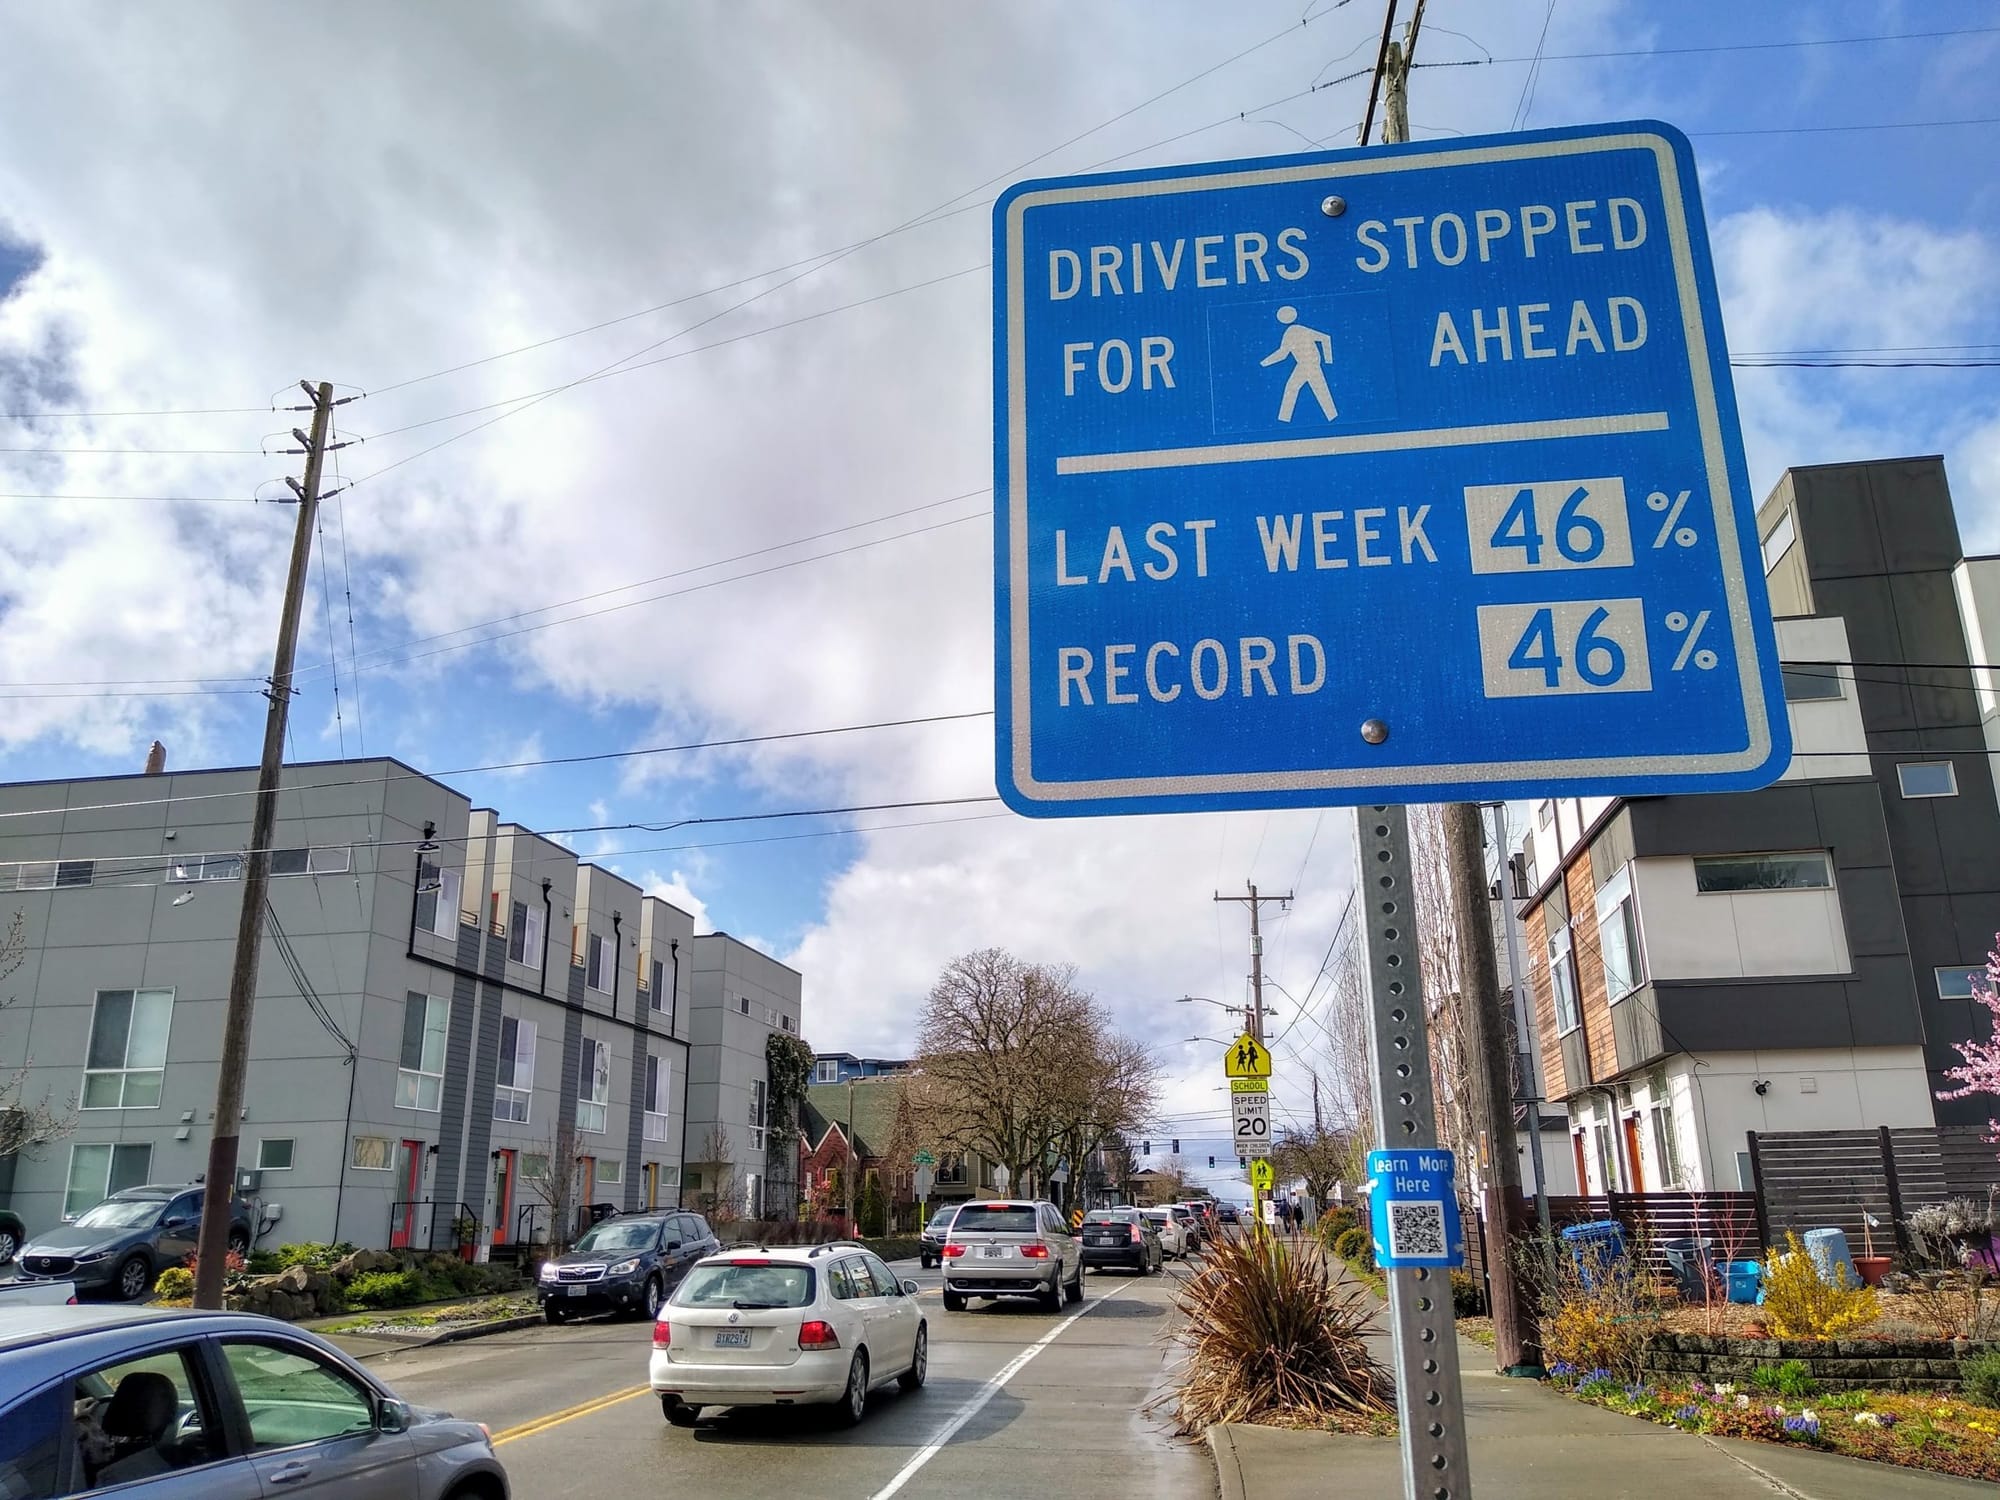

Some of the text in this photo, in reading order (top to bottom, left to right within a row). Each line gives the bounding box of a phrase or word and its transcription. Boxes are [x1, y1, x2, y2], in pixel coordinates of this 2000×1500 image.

[1049, 197, 1647, 302] DRIVERS STOPPED
[1064, 296, 1648, 396] FOR AHEAD
[1056, 487, 1698, 587] LAST WEEK 46 %
[1058, 608, 1719, 707] RECORD 46 %
[1233, 1081, 1265, 1090] SCHOOL
[1234, 1096, 1267, 1105] SPEED
[1238, 1106, 1263, 1115] LIMIT
[1237, 1117, 1267, 1136] 20
[1374, 1156, 1449, 1173] Learn More
[1395, 1176, 1431, 1193] Here
